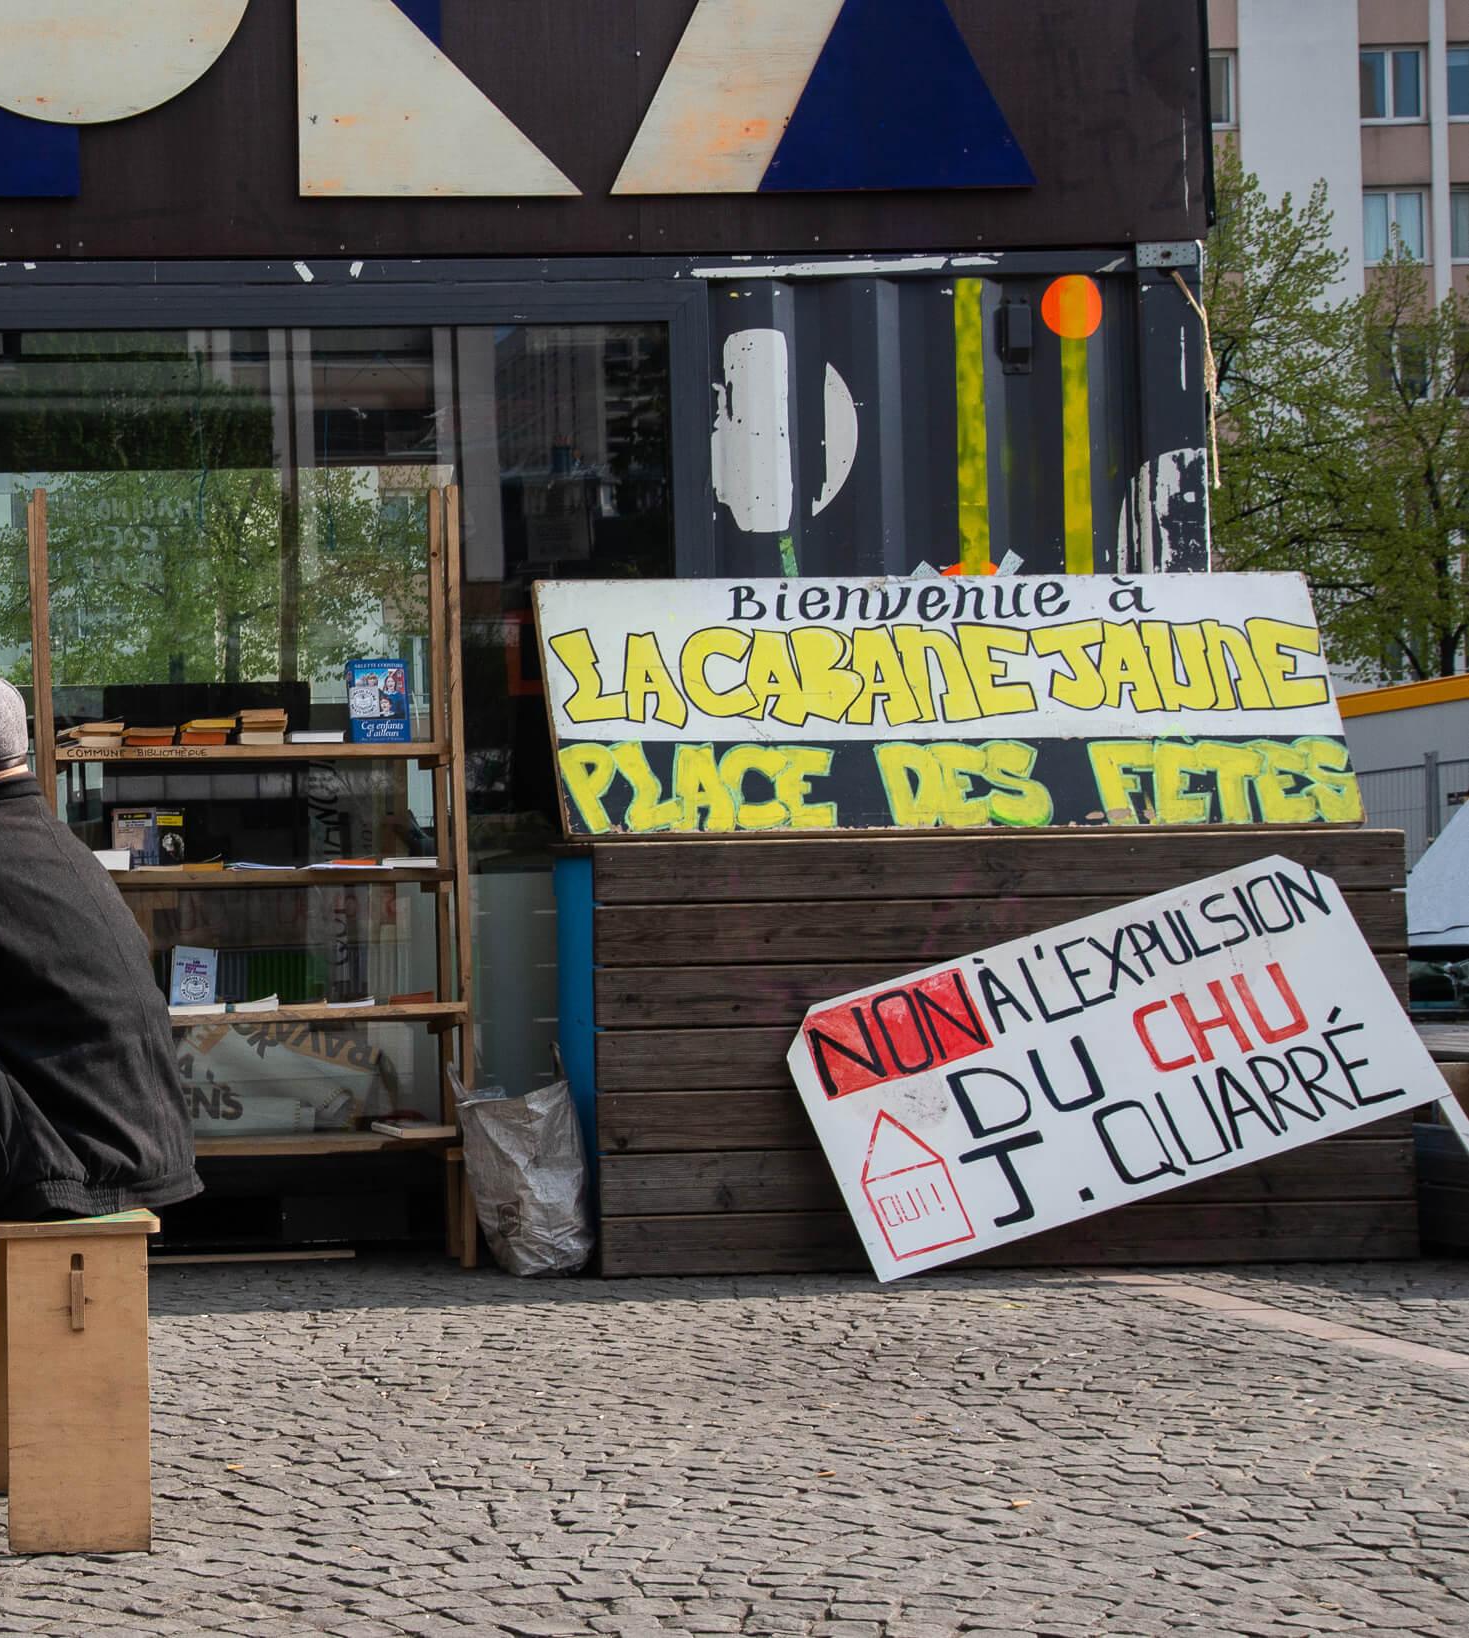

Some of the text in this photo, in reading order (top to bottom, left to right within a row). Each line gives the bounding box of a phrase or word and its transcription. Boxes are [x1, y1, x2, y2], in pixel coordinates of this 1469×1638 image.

[729, 580, 1156, 624] Bienvenue à
[548, 616, 1331, 728] LA CABANE JAUNE
[67, 748, 126, 758] COMMUNE
[376, 719, 404, 732] enfants
[558, 740, 838, 836] PLACE
[874, 738, 1054, 828] DES
[806, 869, 1331, 1097] NON À L'EXPULSION
[1132, 962, 1310, 1073] CHU
[947, 1036, 1106, 1139] DU
[1092, 1007, 1406, 1185] QUARRÉ
